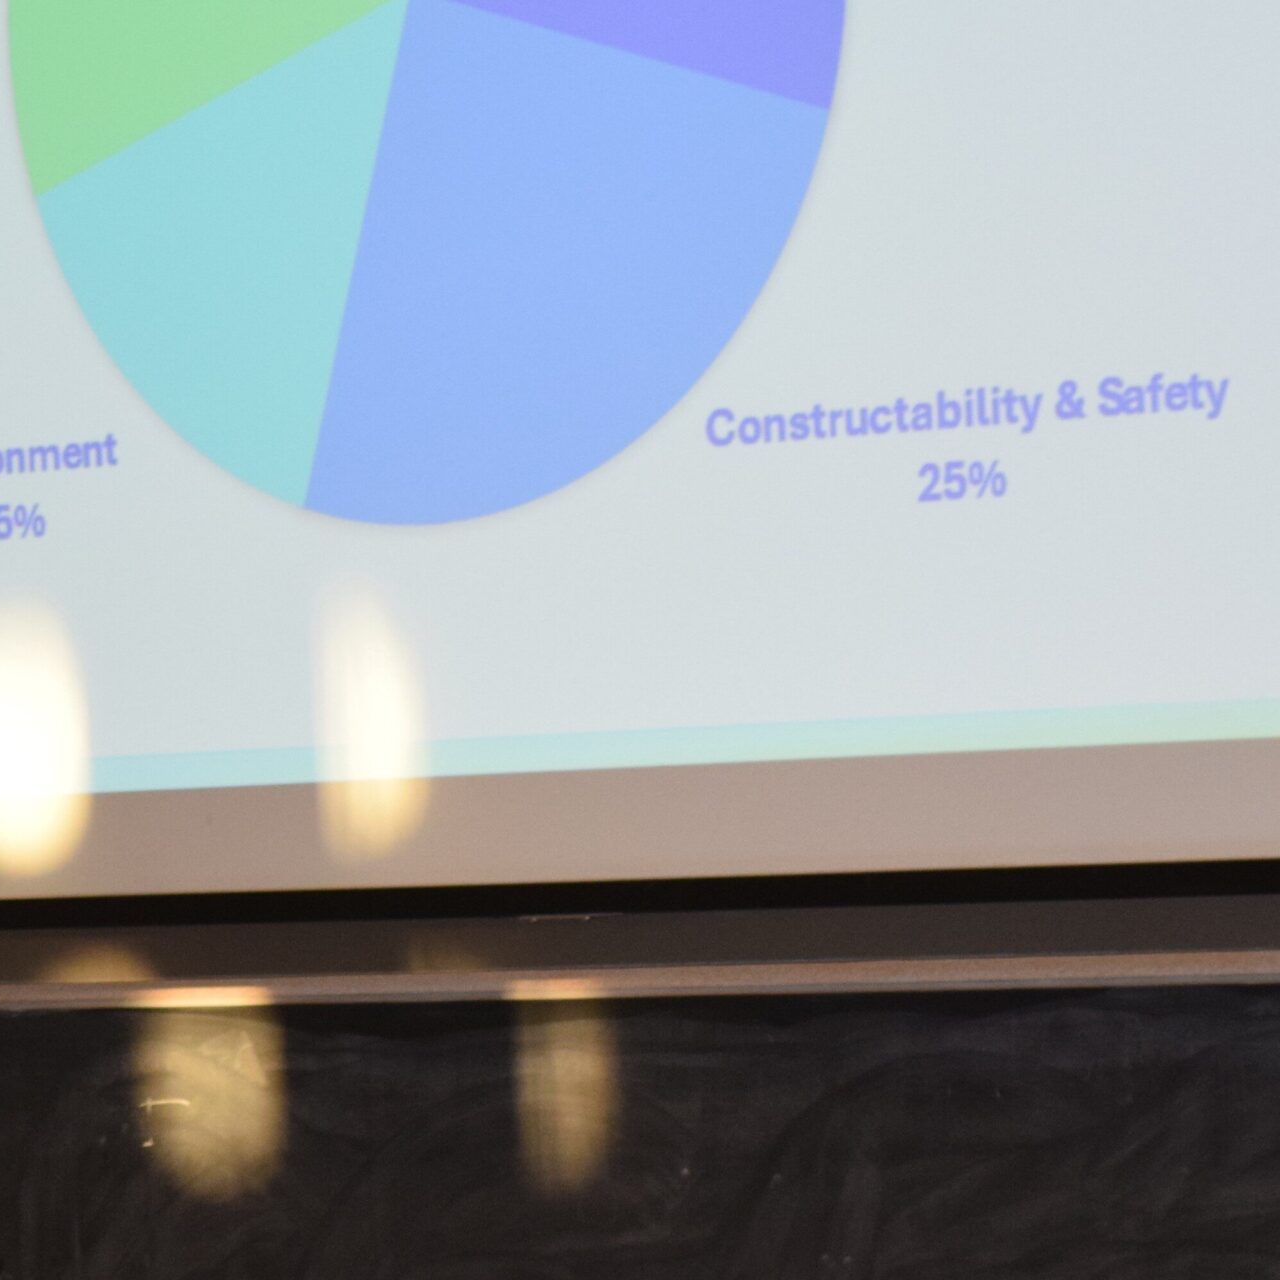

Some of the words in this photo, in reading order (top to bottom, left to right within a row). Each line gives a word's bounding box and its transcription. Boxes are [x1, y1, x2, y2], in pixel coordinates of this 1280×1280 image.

[705, 386, 1043, 447] Constructability
[1054, 379, 1088, 421] &
[1096, 372, 1230, 420] Safety
[917, 459, 1008, 503] 25%
